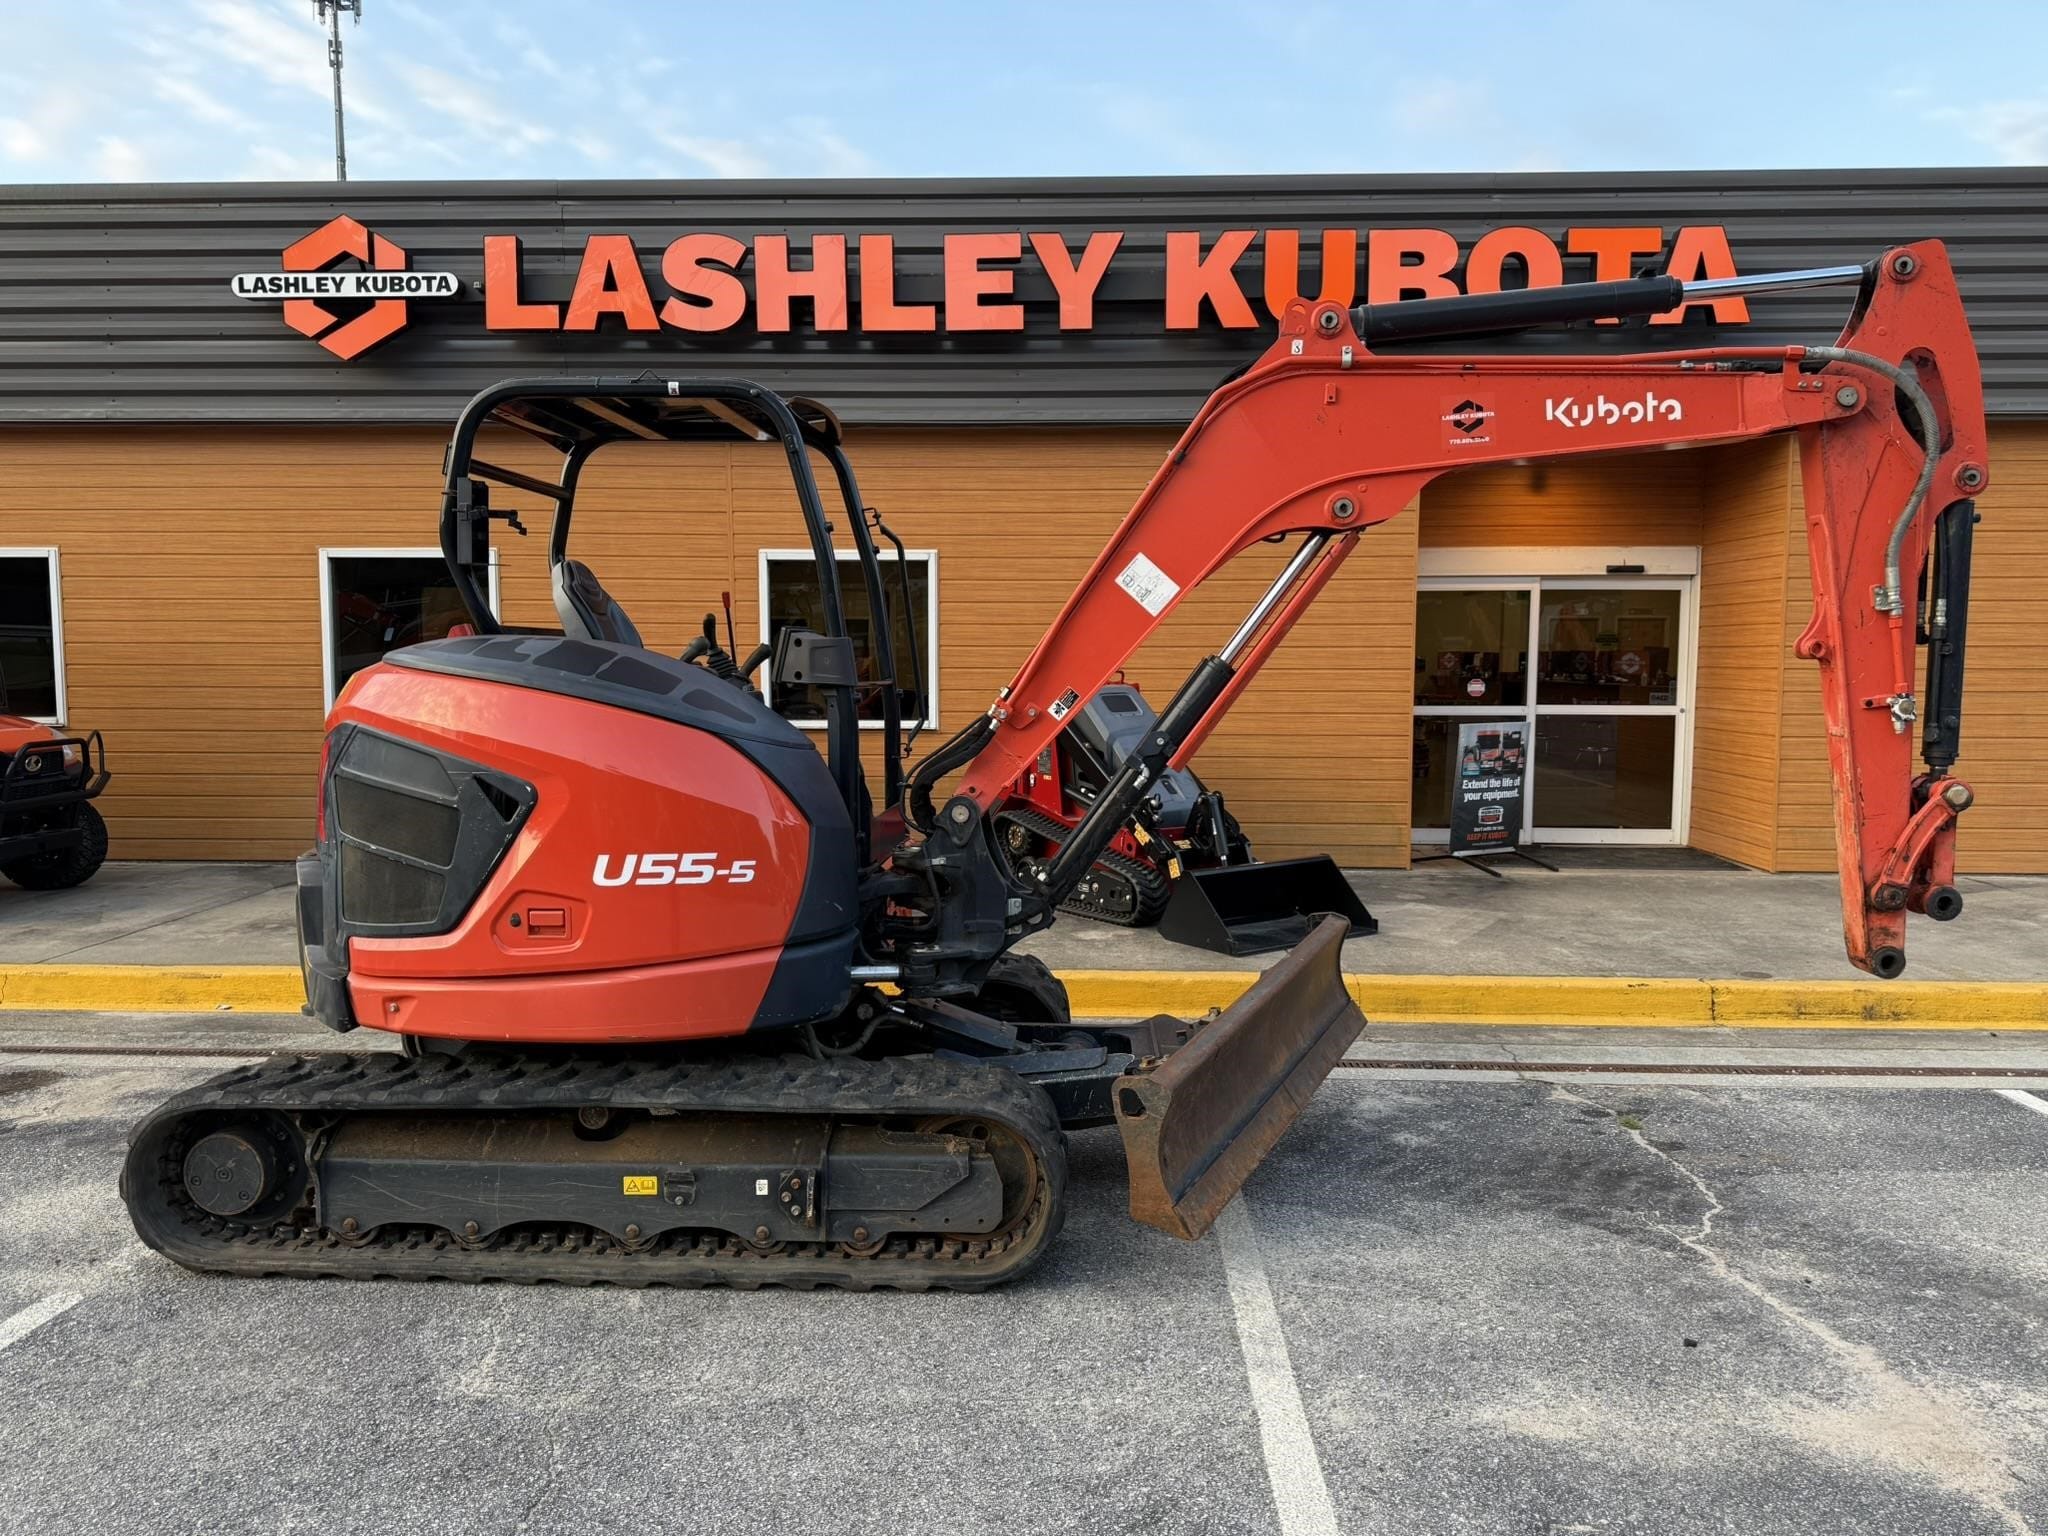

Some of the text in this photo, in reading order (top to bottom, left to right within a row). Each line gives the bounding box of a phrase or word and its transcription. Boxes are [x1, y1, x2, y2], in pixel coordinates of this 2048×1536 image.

[238, 275, 452, 293] LASHLEY KUBOTA
[484, 226, 1750, 331] LASHLEY KUBOTA
[1545, 391, 1682, 428] Kubota
[1462, 776, 1520, 789] Extend the life of
[1464, 789, 1519, 803] your equipment.
[592, 852, 757, 887] U55-5
